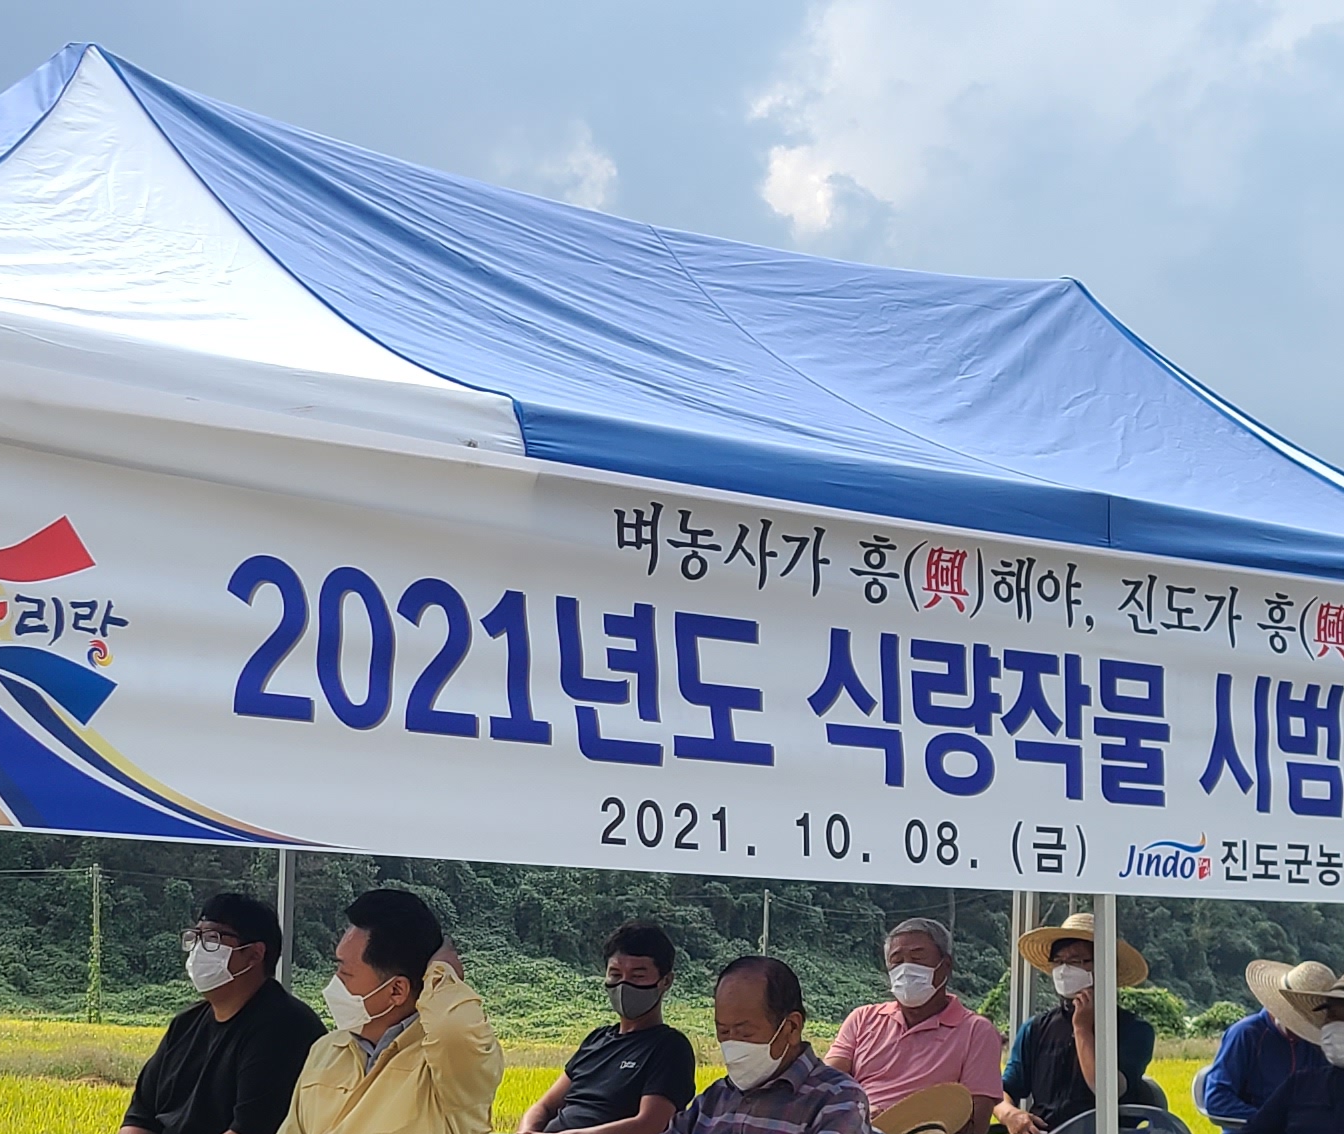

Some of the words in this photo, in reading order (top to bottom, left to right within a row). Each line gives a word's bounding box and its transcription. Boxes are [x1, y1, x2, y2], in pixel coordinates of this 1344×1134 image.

[613, 501, 831, 597] 벼농사가
[1117, 573, 1243, 649] 진도가
[227, 554, 775, 767] 2021년도
[807, 627, 1171, 808] 식량작물
[601, 797, 756, 857] 2021.
[795, 812, 870, 863] 10.
[904, 819, 978, 869] 08.
[1012, 821, 1086, 877] (금)
[1119, 844, 1197, 880] Jindo
